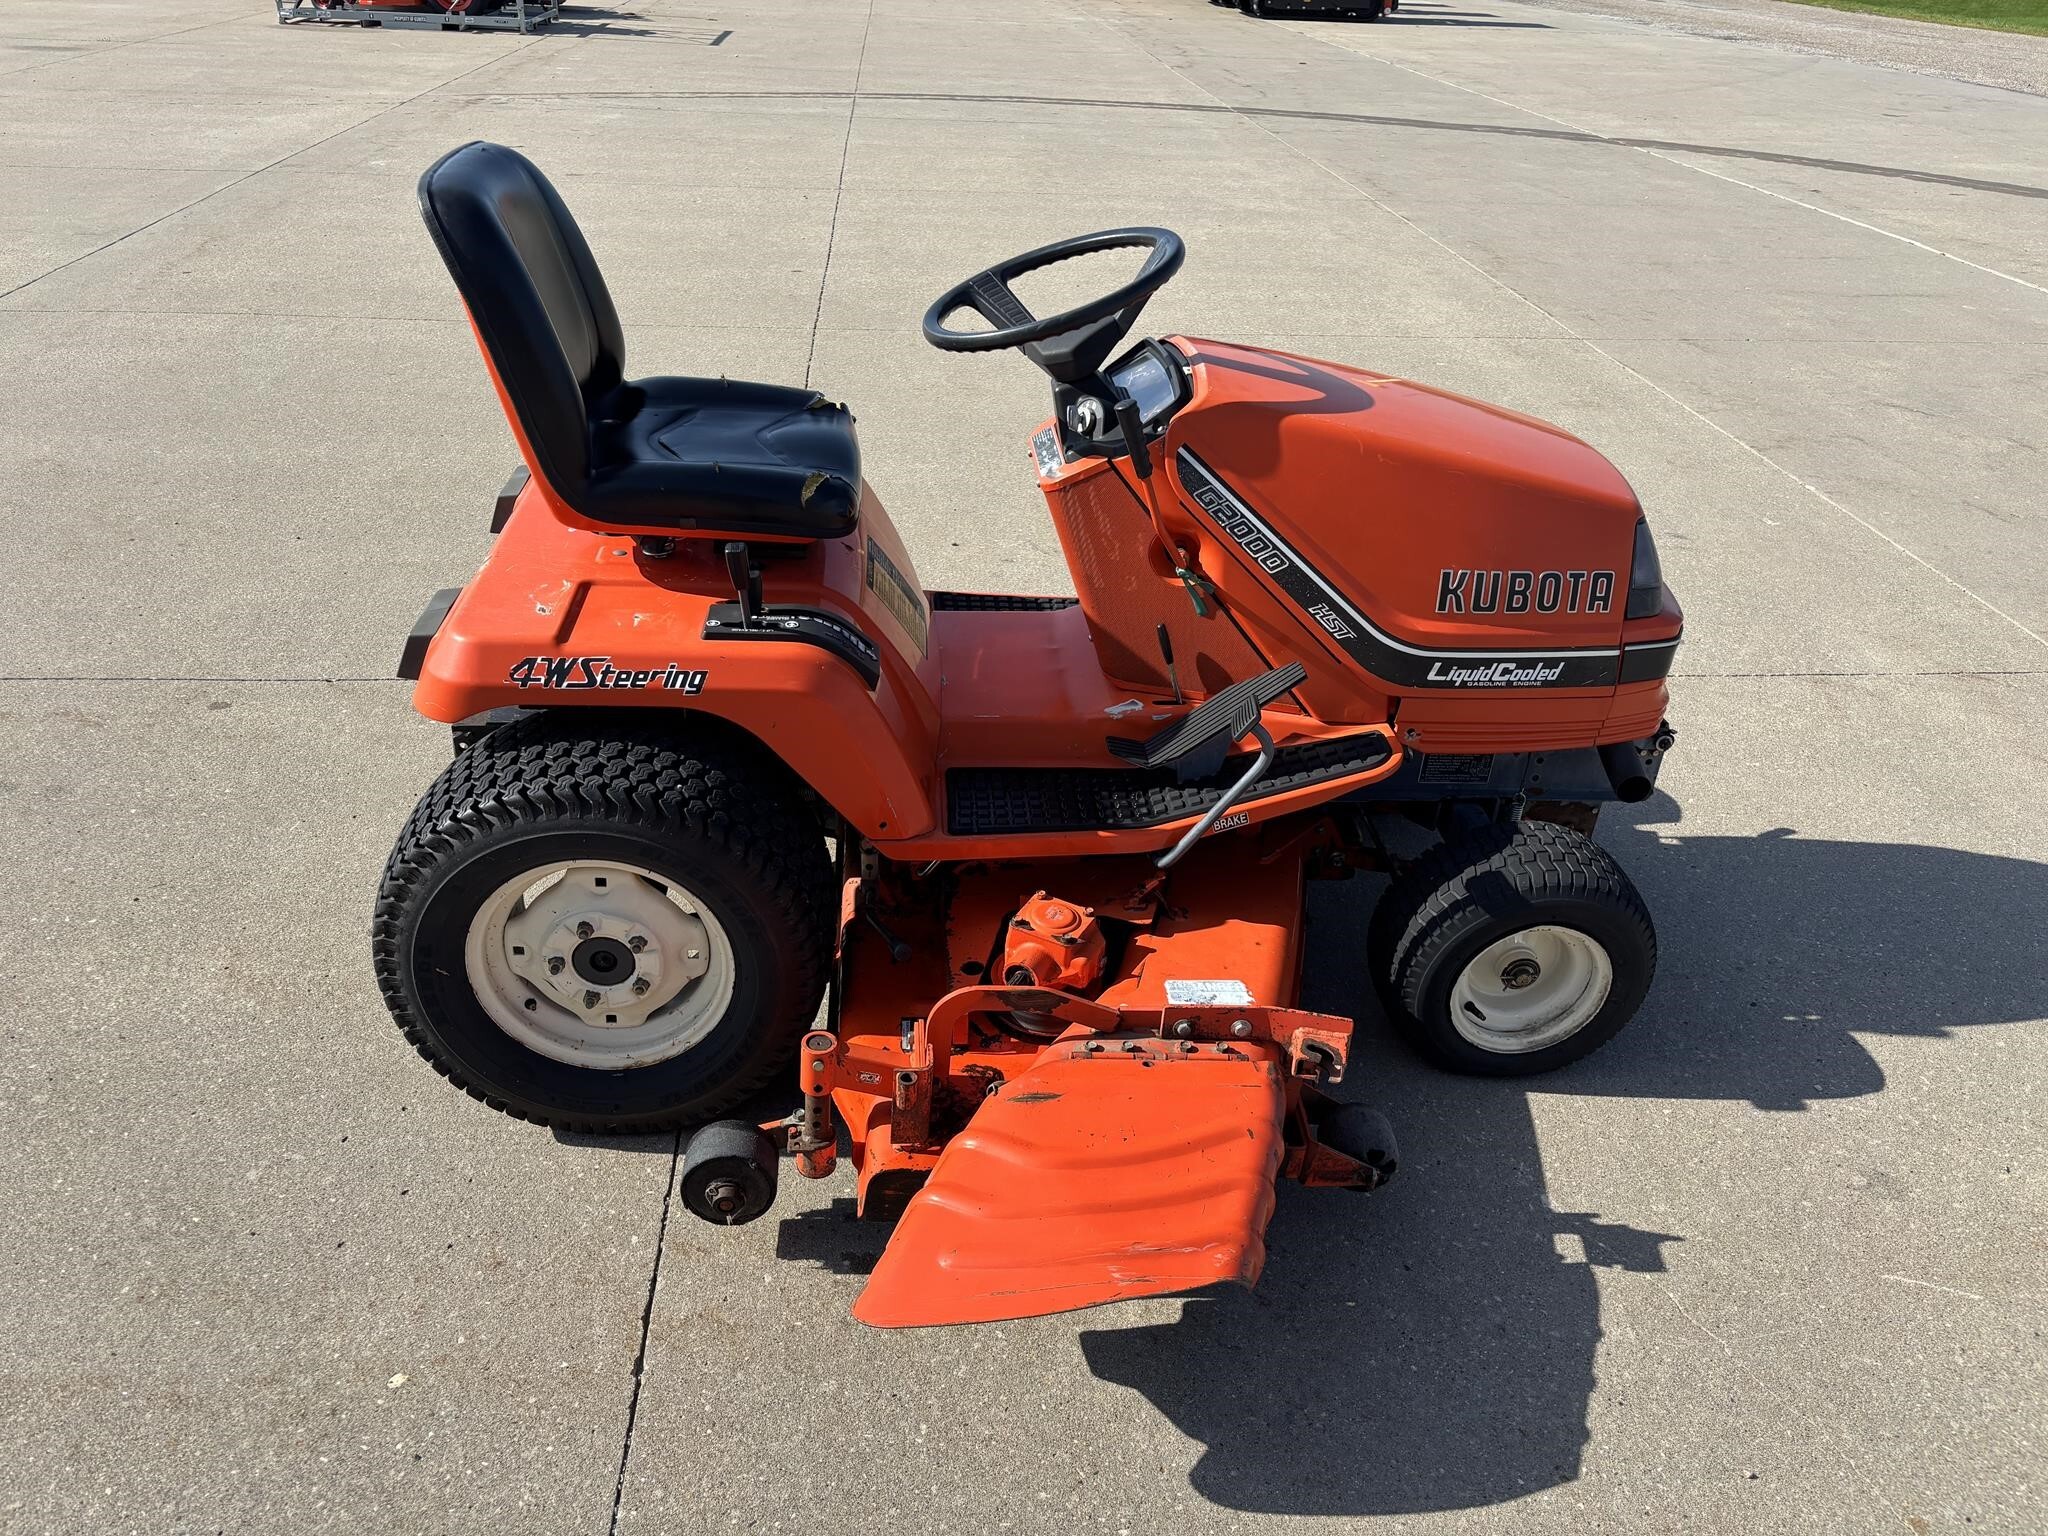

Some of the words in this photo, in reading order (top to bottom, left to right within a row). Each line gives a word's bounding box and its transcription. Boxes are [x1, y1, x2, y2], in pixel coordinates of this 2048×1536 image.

[1193, 485, 1289, 574] G2000
[1435, 569, 1615, 614] KUBOTA
[1308, 603, 1357, 639] HST
[508, 656, 709, 696] 4WSteering
[1213, 813, 1248, 831] BRAKE
